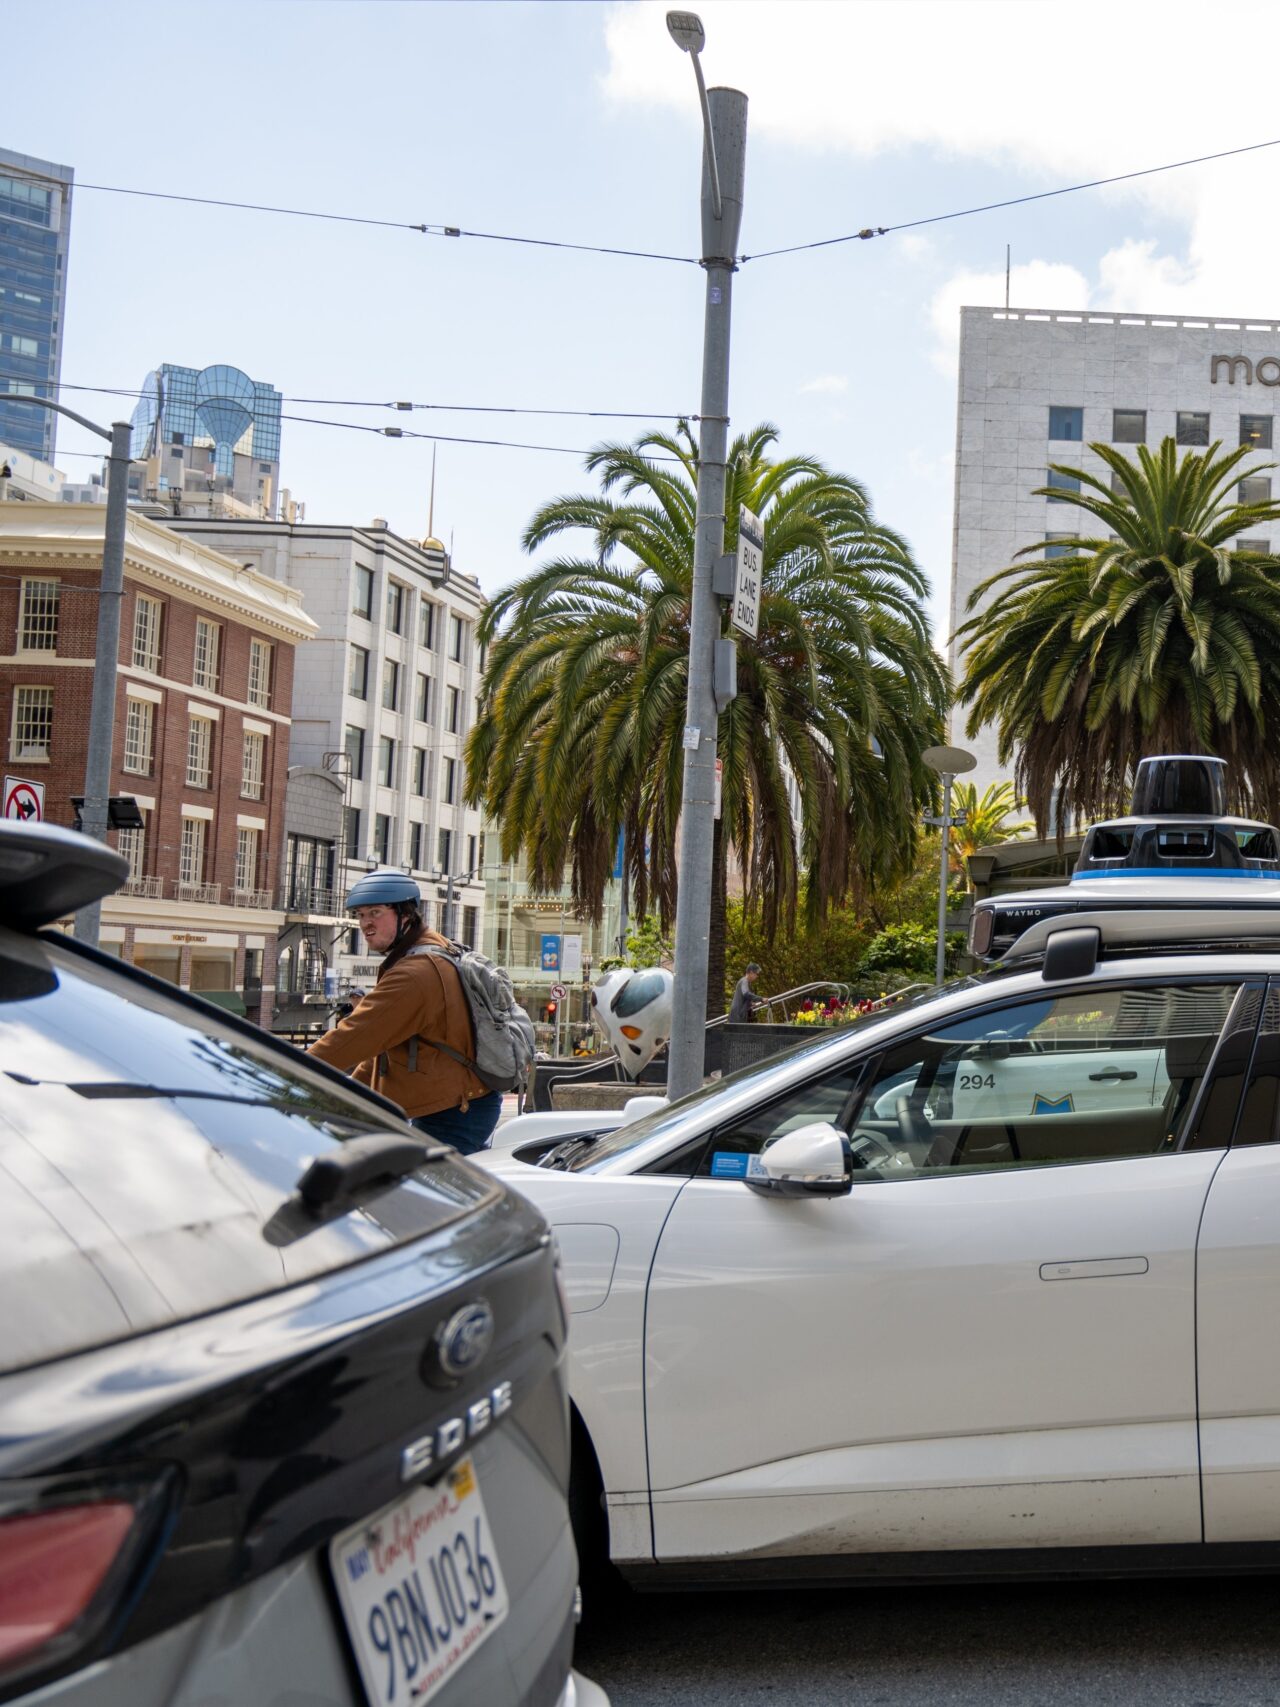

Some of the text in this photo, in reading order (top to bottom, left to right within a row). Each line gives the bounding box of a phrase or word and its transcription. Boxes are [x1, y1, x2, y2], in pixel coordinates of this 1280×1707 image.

[743, 547, 757, 572] BUS
[739, 573, 756, 601] LANE
[737, 601, 755, 628] ENDS
[1006, 909, 1041, 917] WAYMO
[960, 1074, 996, 1090] 294
[368, 1514, 497, 1701] 9BNJ036
